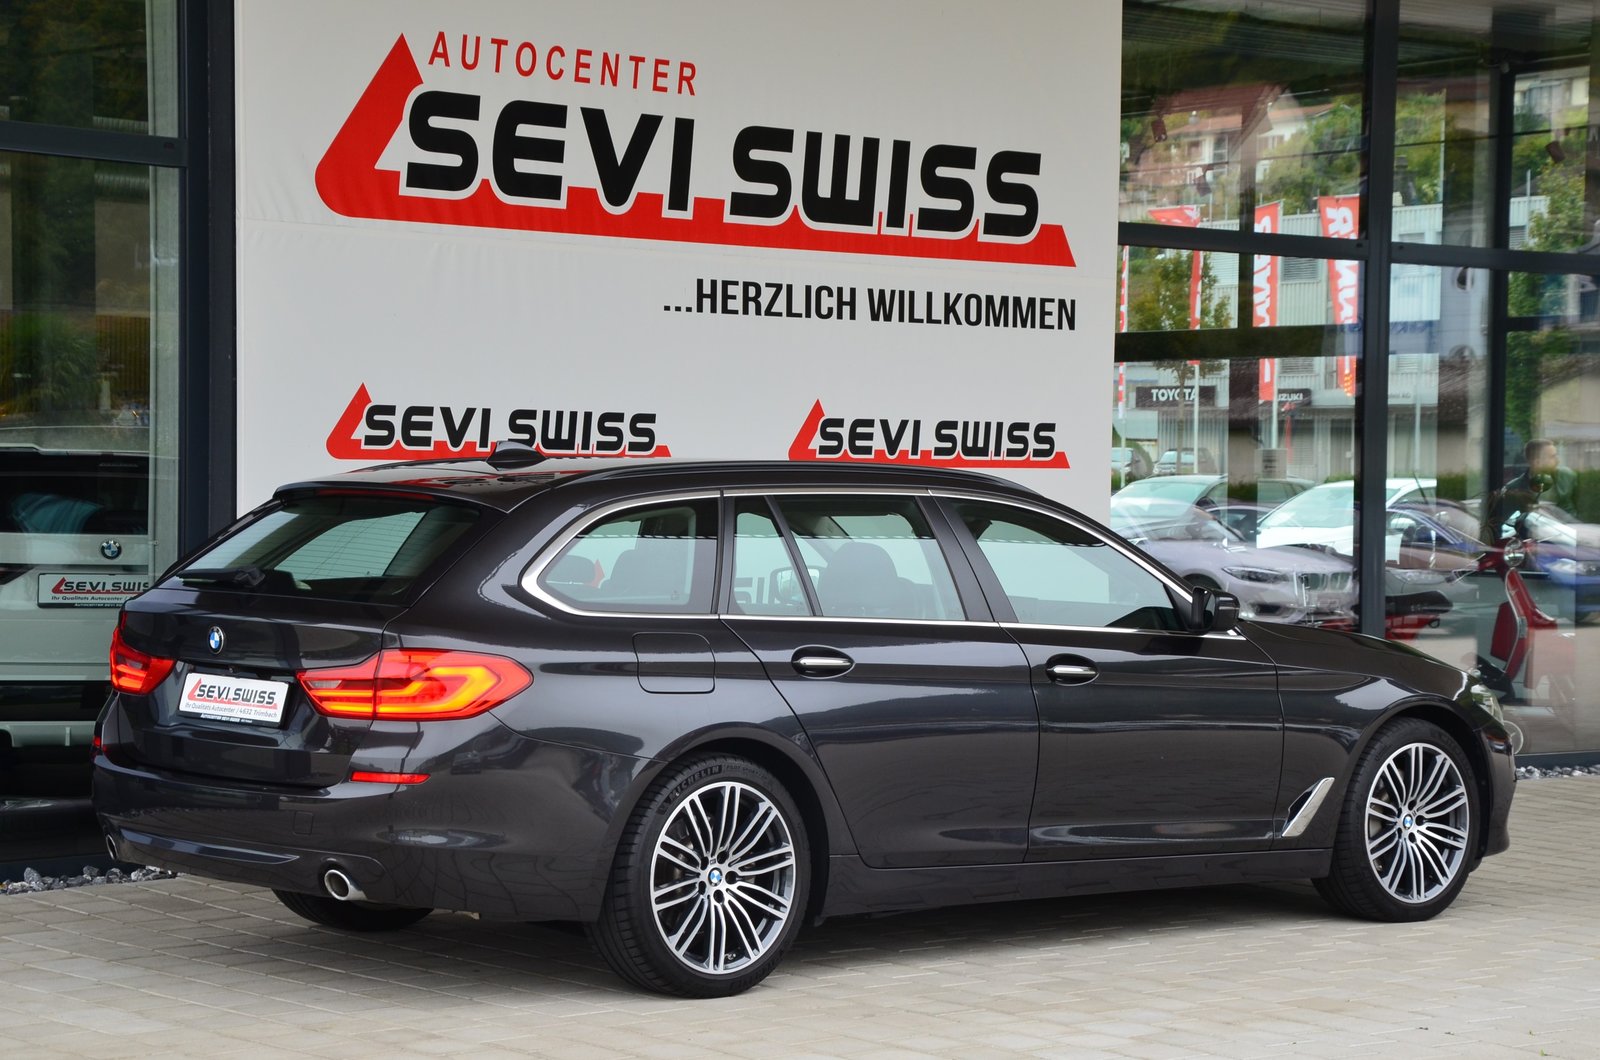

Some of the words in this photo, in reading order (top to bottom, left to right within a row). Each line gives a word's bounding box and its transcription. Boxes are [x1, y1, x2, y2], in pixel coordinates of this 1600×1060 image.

[428, 31, 698, 96] AUTOCENTER
[405, 90, 695, 212] SEVI
[728, 125, 1042, 238] SWISS
[867, 288, 1077, 331] WILLKOMMEN
[364, 404, 491, 449] SEVI
[507, 408, 657, 453] SWISS
[818, 417, 921, 457] SEVI
[933, 420, 1057, 459] SWISS
[63, 581, 106, 592] SEVI
[196, 684, 231, 701] SEVI
[232, 688, 276, 705] SWISS
[211, 705, 235, 713] Autocenter
[669, 764, 721, 800] MICHELIN
